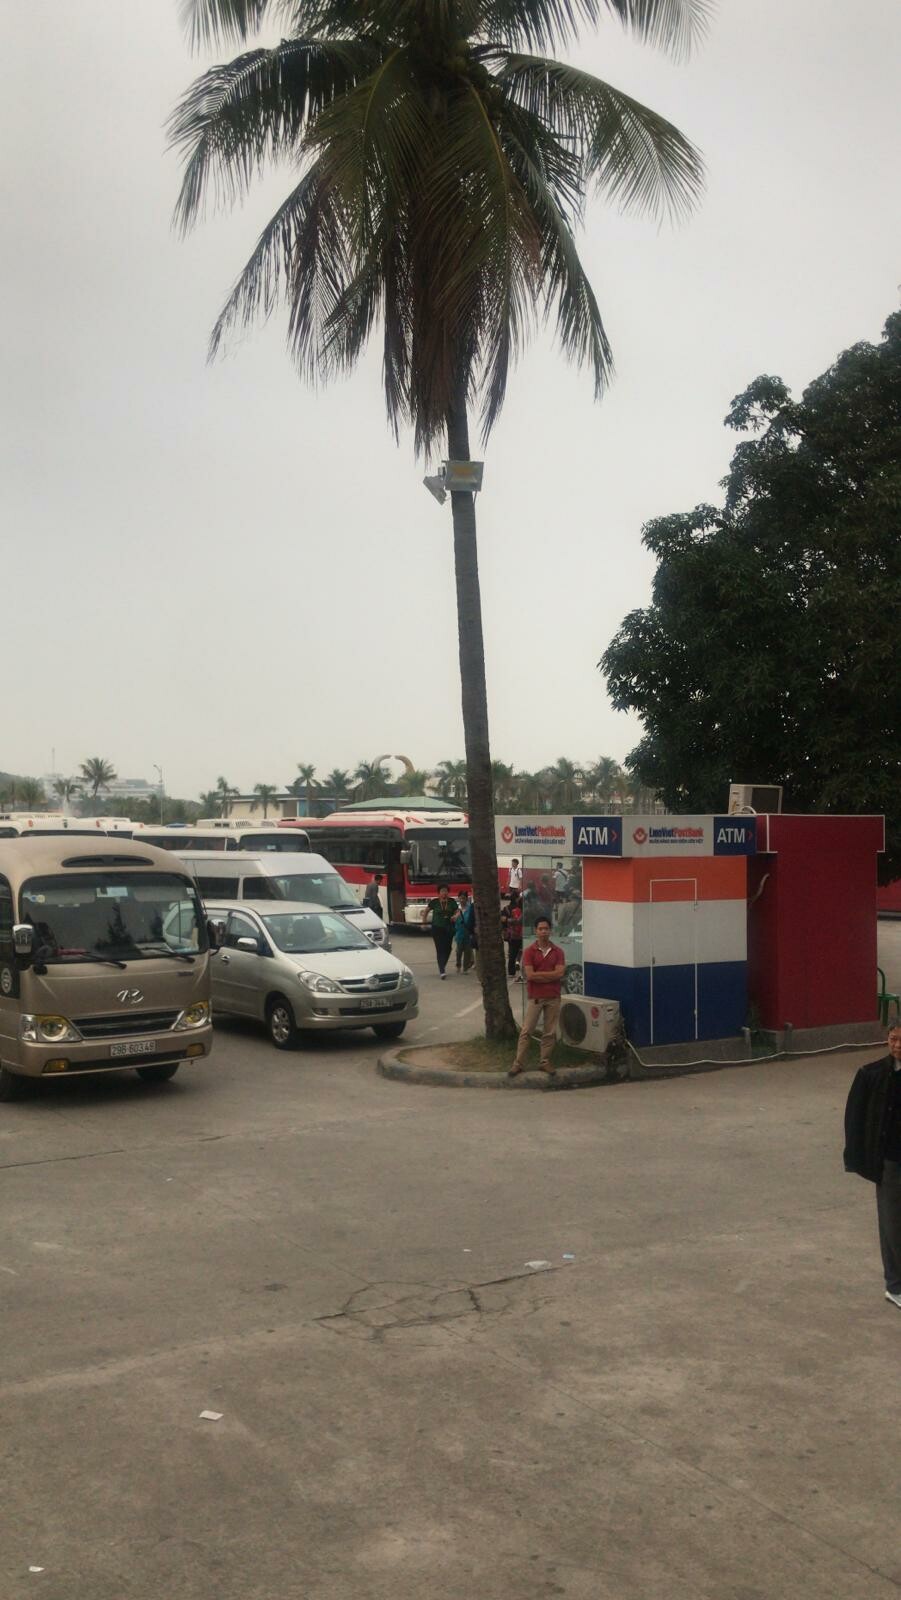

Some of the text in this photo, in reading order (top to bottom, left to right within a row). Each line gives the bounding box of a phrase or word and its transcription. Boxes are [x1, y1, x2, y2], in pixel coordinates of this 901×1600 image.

[578, 826, 608, 845] ATM
[716, 827, 745, 844] ATM
[591, 1019, 599, 1027] LG
